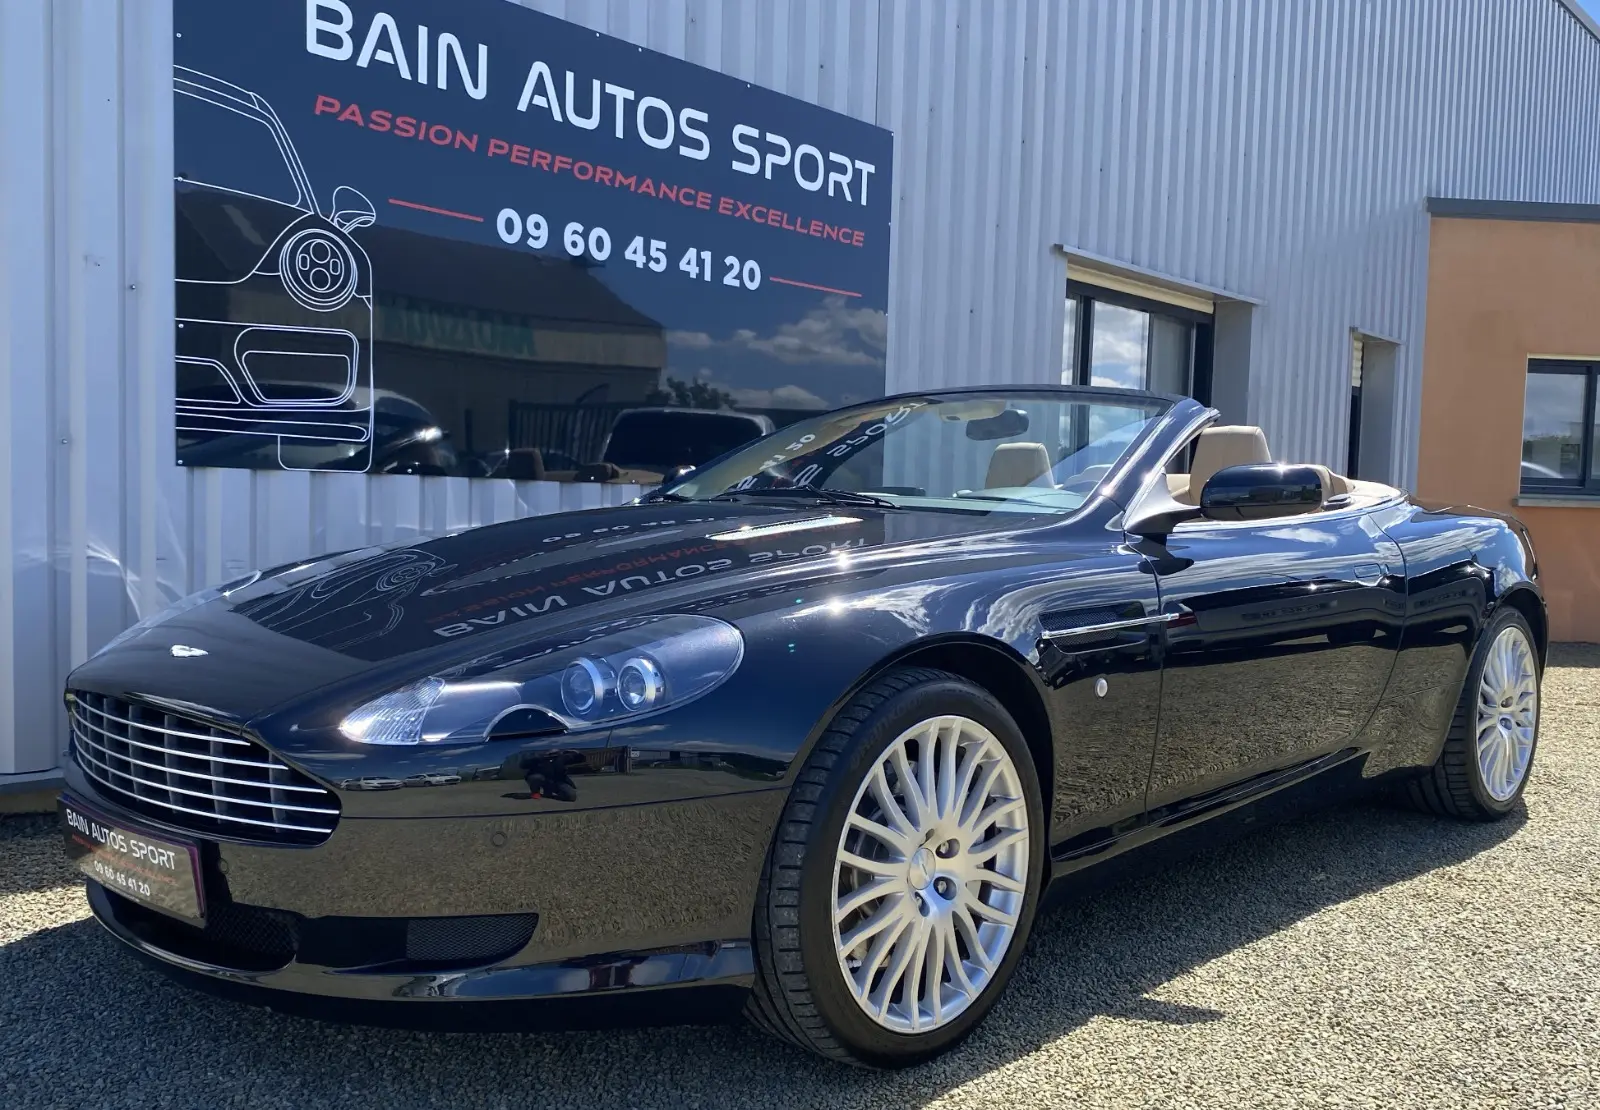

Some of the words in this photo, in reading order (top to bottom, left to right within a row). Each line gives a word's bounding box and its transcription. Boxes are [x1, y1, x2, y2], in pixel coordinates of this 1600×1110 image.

[306, 0, 488, 100] BAIN
[516, 60, 711, 161] AUTOS
[731, 123, 876, 206] SPORT
[313, 94, 479, 153] PASSION
[487, 138, 713, 211] PERFORMANCE
[718, 197, 866, 248] EXCELLENCE
[496, 207, 549, 249] 09
[563, 221, 612, 261] 60
[624, 235, 668, 273] 45
[678, 247, 712, 282] 41
[722, 255, 762, 291] 20
[65, 808, 89, 836] BAIN
[91, 822, 128, 853] AUTOS
[130, 839, 175, 870] SPORT
[93, 860, 104, 875] 09
[104, 866, 115, 881] 60
[116, 872, 127, 887] 45
[127, 878, 138, 892] 41
[139, 882, 151, 897] 20
